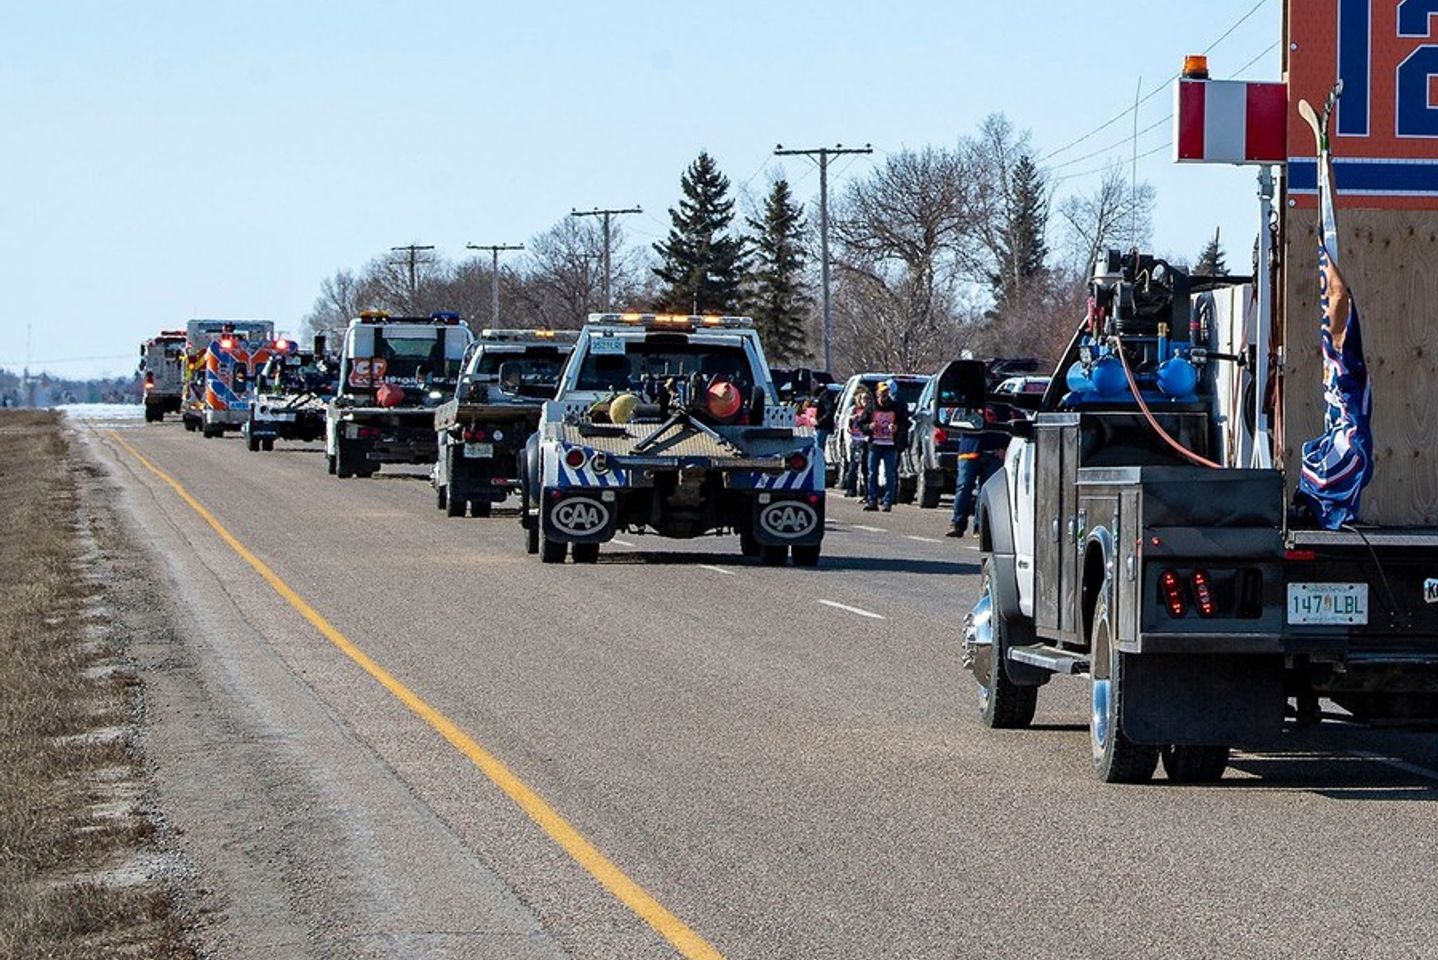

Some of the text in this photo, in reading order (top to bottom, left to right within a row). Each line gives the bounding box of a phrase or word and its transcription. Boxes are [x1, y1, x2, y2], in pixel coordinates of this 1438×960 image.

[558, 503, 599, 530] CAA
[768, 506, 807, 534] CAA
[1293, 595, 1364, 614] 147 LBL
